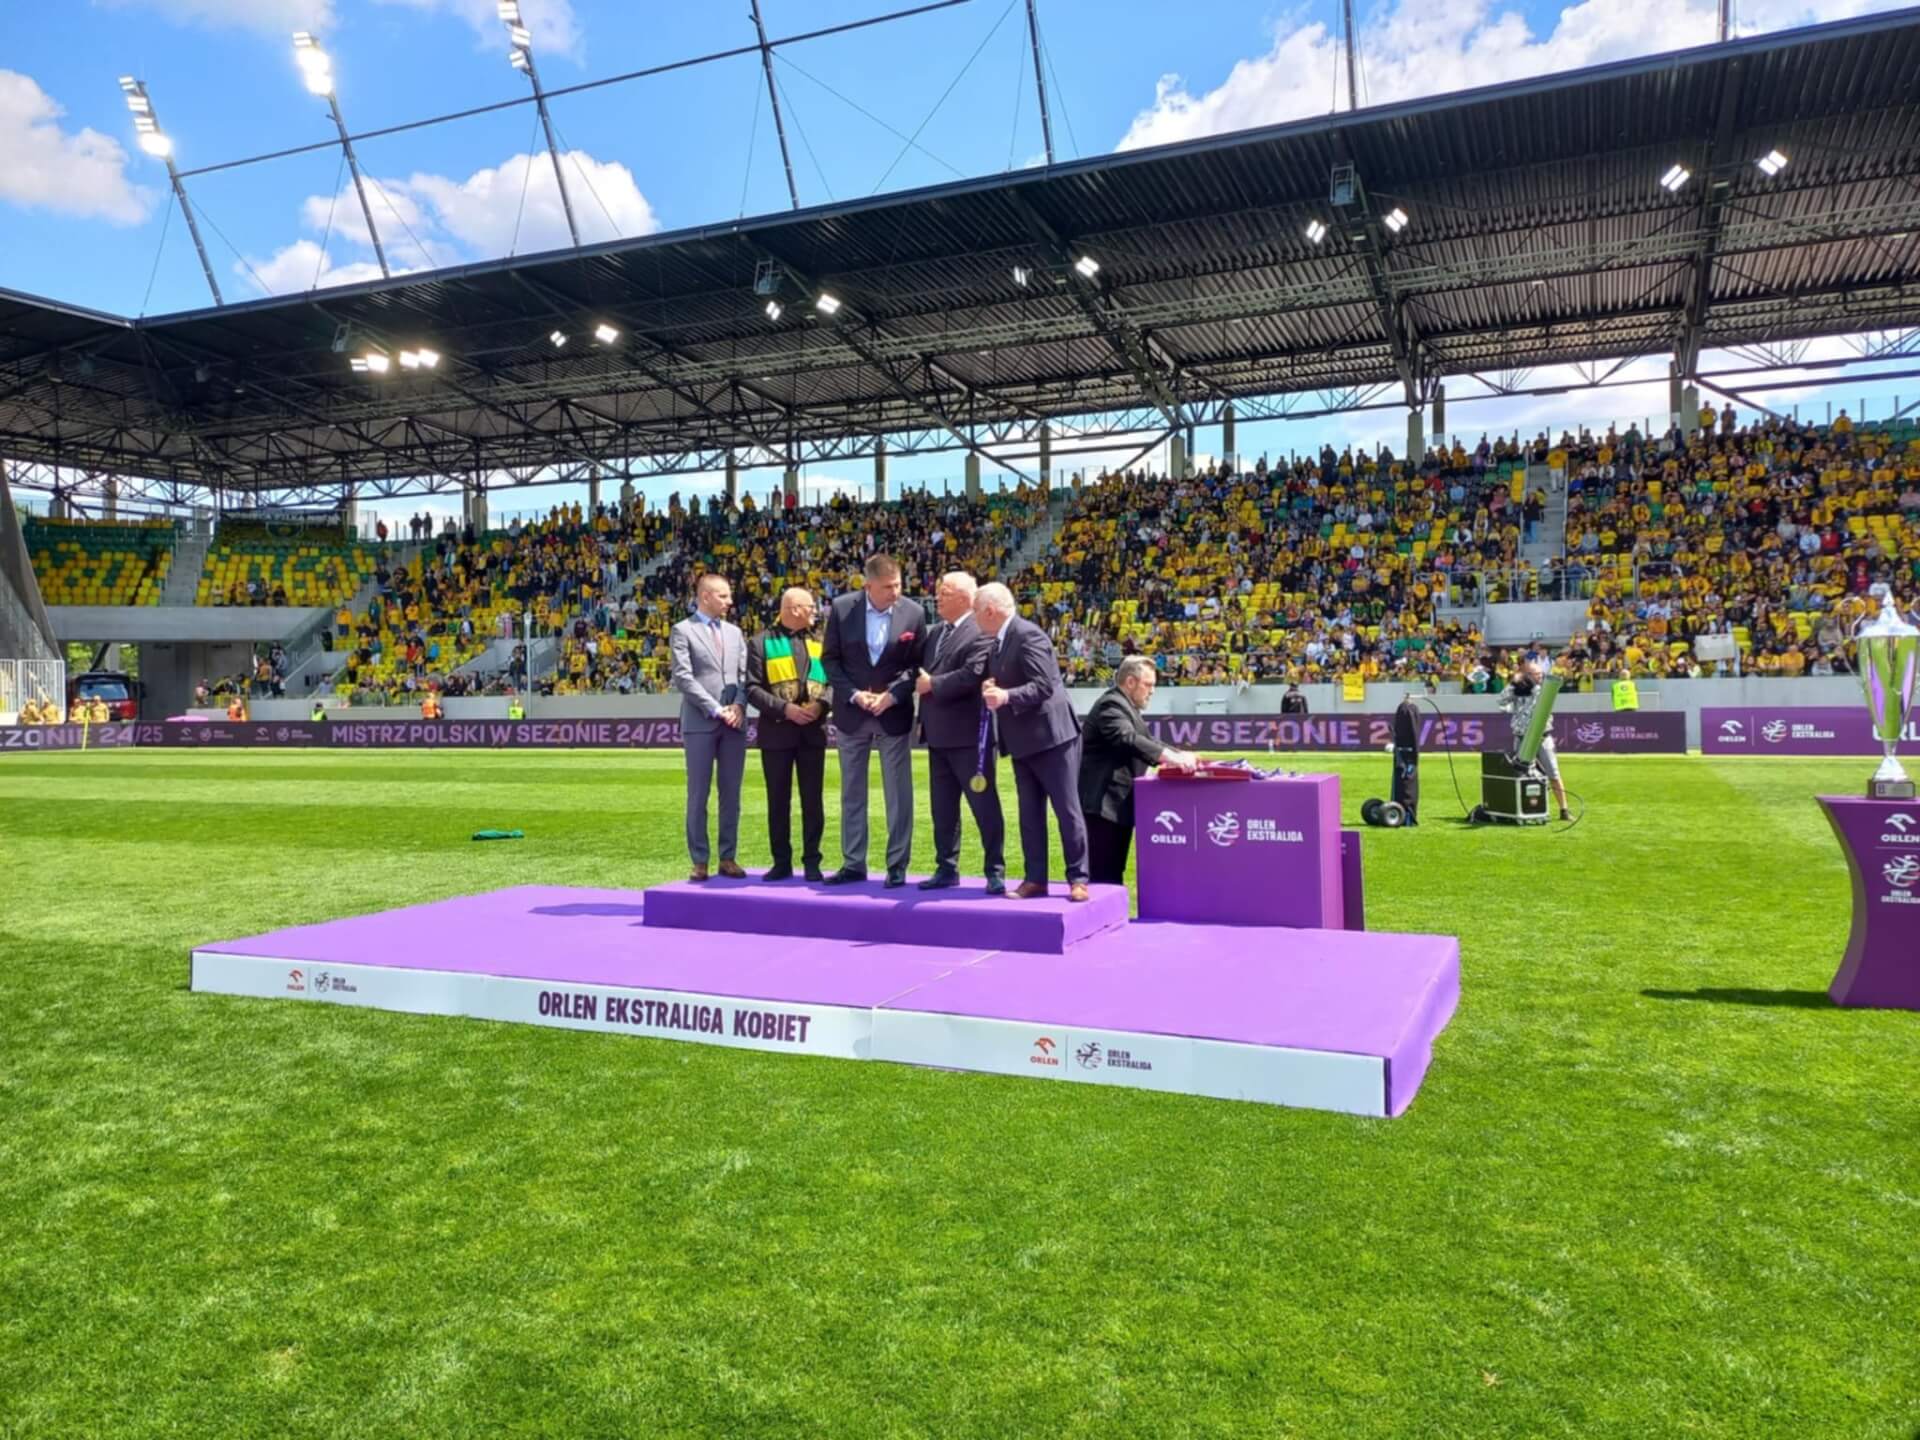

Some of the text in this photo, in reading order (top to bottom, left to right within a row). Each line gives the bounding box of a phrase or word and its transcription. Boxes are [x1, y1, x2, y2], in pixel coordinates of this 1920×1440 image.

[0, 725, 163, 748] ZONIE 24/25
[332, 724, 407, 744] MISTRZ
[410, 724, 485, 744] POLSKI
[490, 724, 512, 745] W
[516, 723, 610, 744] SEZONIE
[616, 723, 684, 743] 24/25
[1168, 720, 1204, 745] W
[1210, 720, 1361, 745] SEZONIE
[1369, 719, 1485, 746] 2/25
[1246, 819, 1276, 830] ORLEN
[1151, 834, 1187, 844] ORLEN
[1246, 830, 1304, 842] EKSTRALIGA
[538, 990, 811, 1044] ORLEN EKSTRALIGA KOBIET
[1030, 1055, 1059, 1066] ORLEN
[1107, 1049, 1131, 1060] ORLEN
